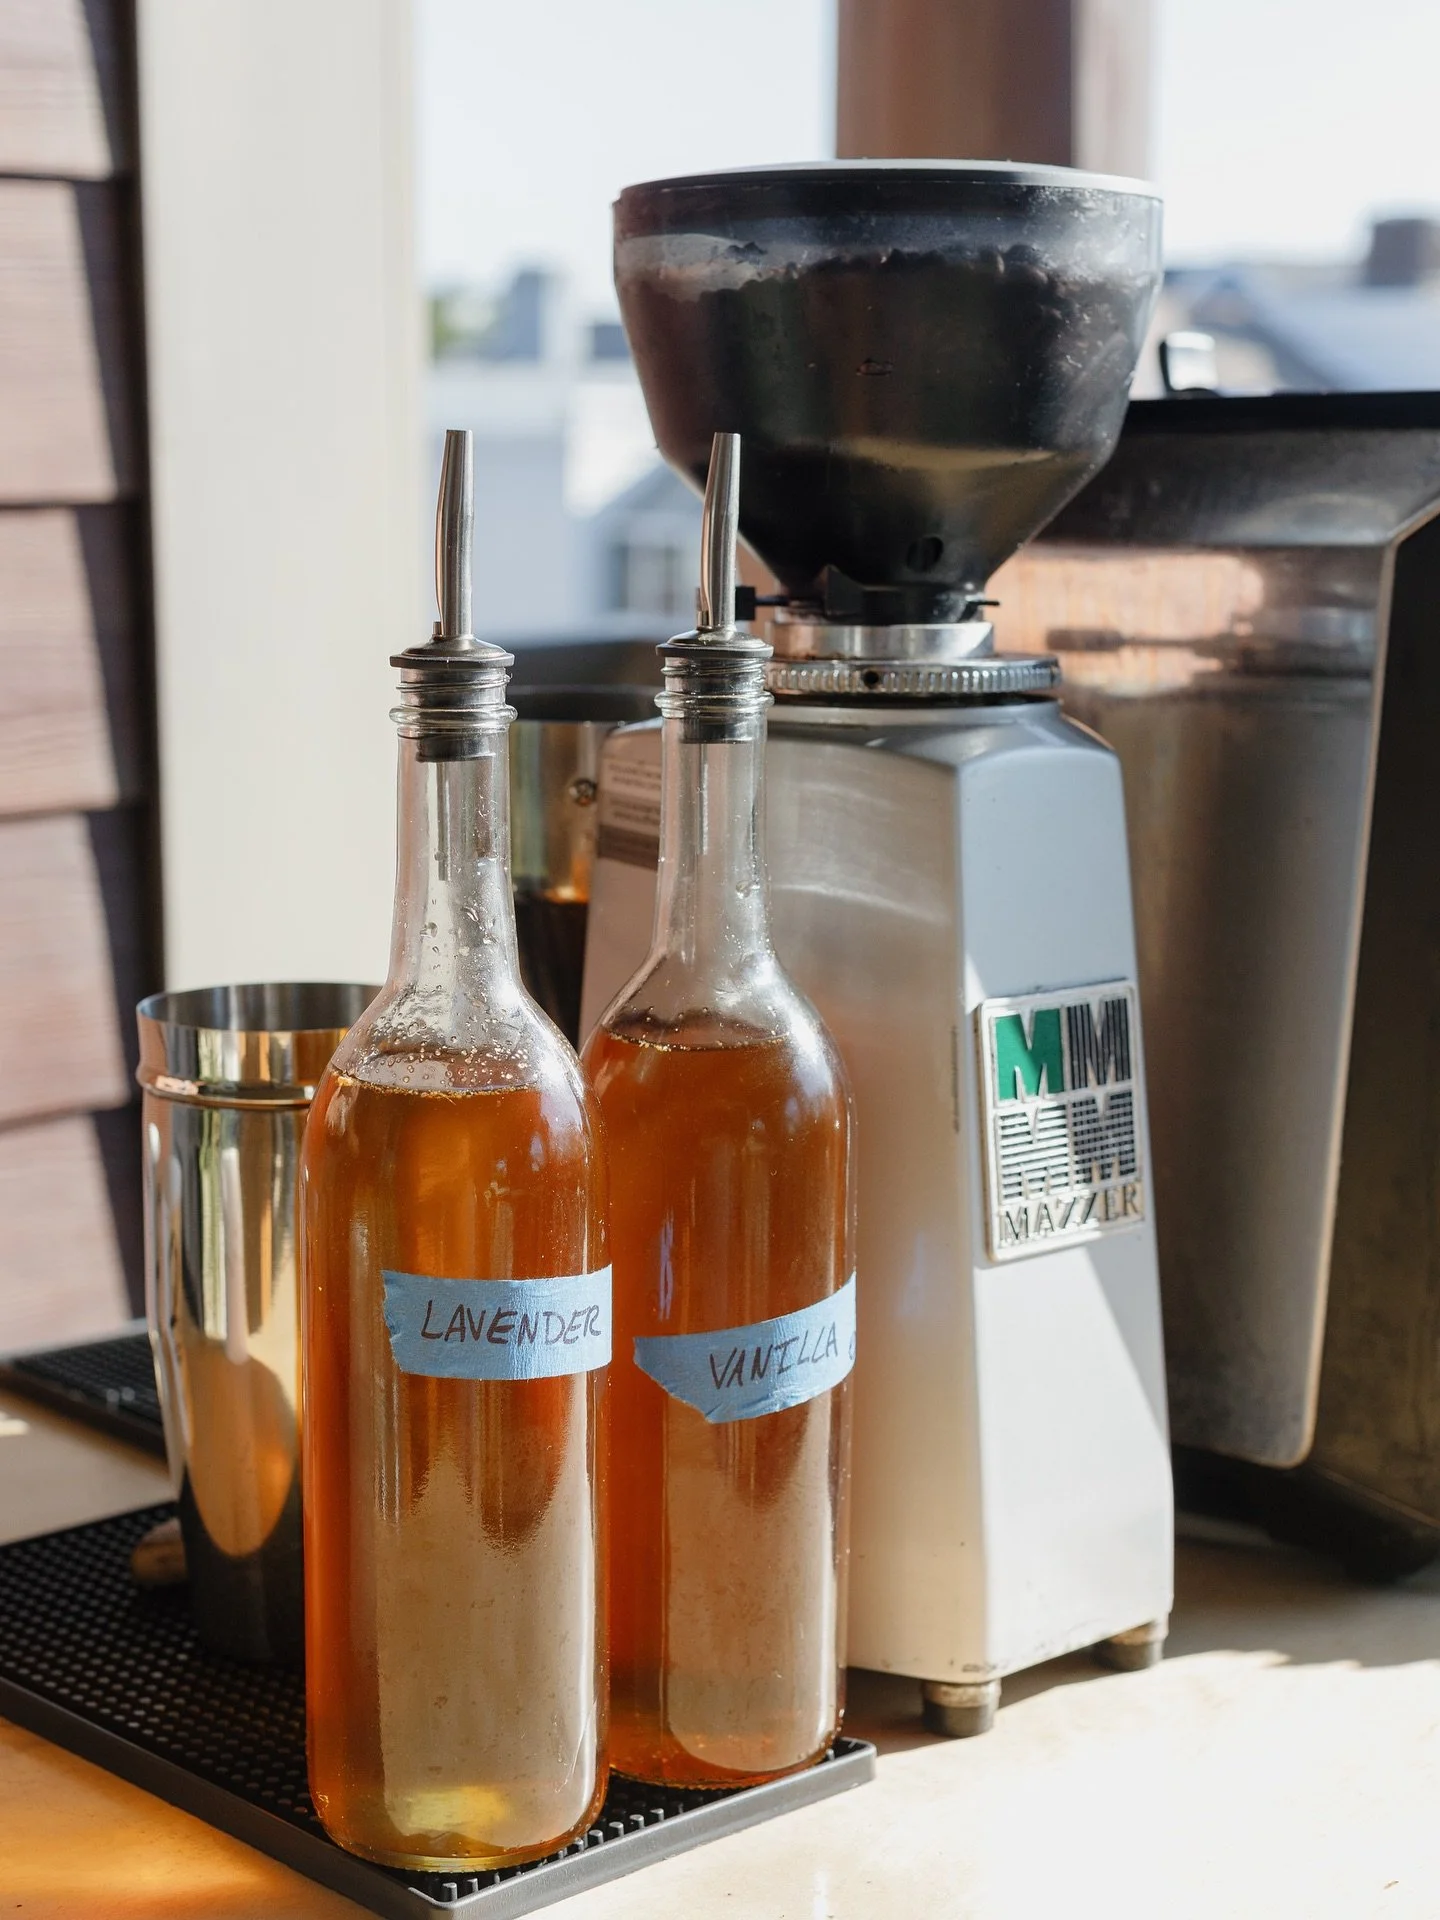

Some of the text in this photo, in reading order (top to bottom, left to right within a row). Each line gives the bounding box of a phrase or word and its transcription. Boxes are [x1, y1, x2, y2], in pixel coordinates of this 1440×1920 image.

[1000, 1182, 1140, 1246] MAZZER
[420, 1299, 602, 1346] LAVENDER
[709, 1322, 838, 1390] VANILLA
